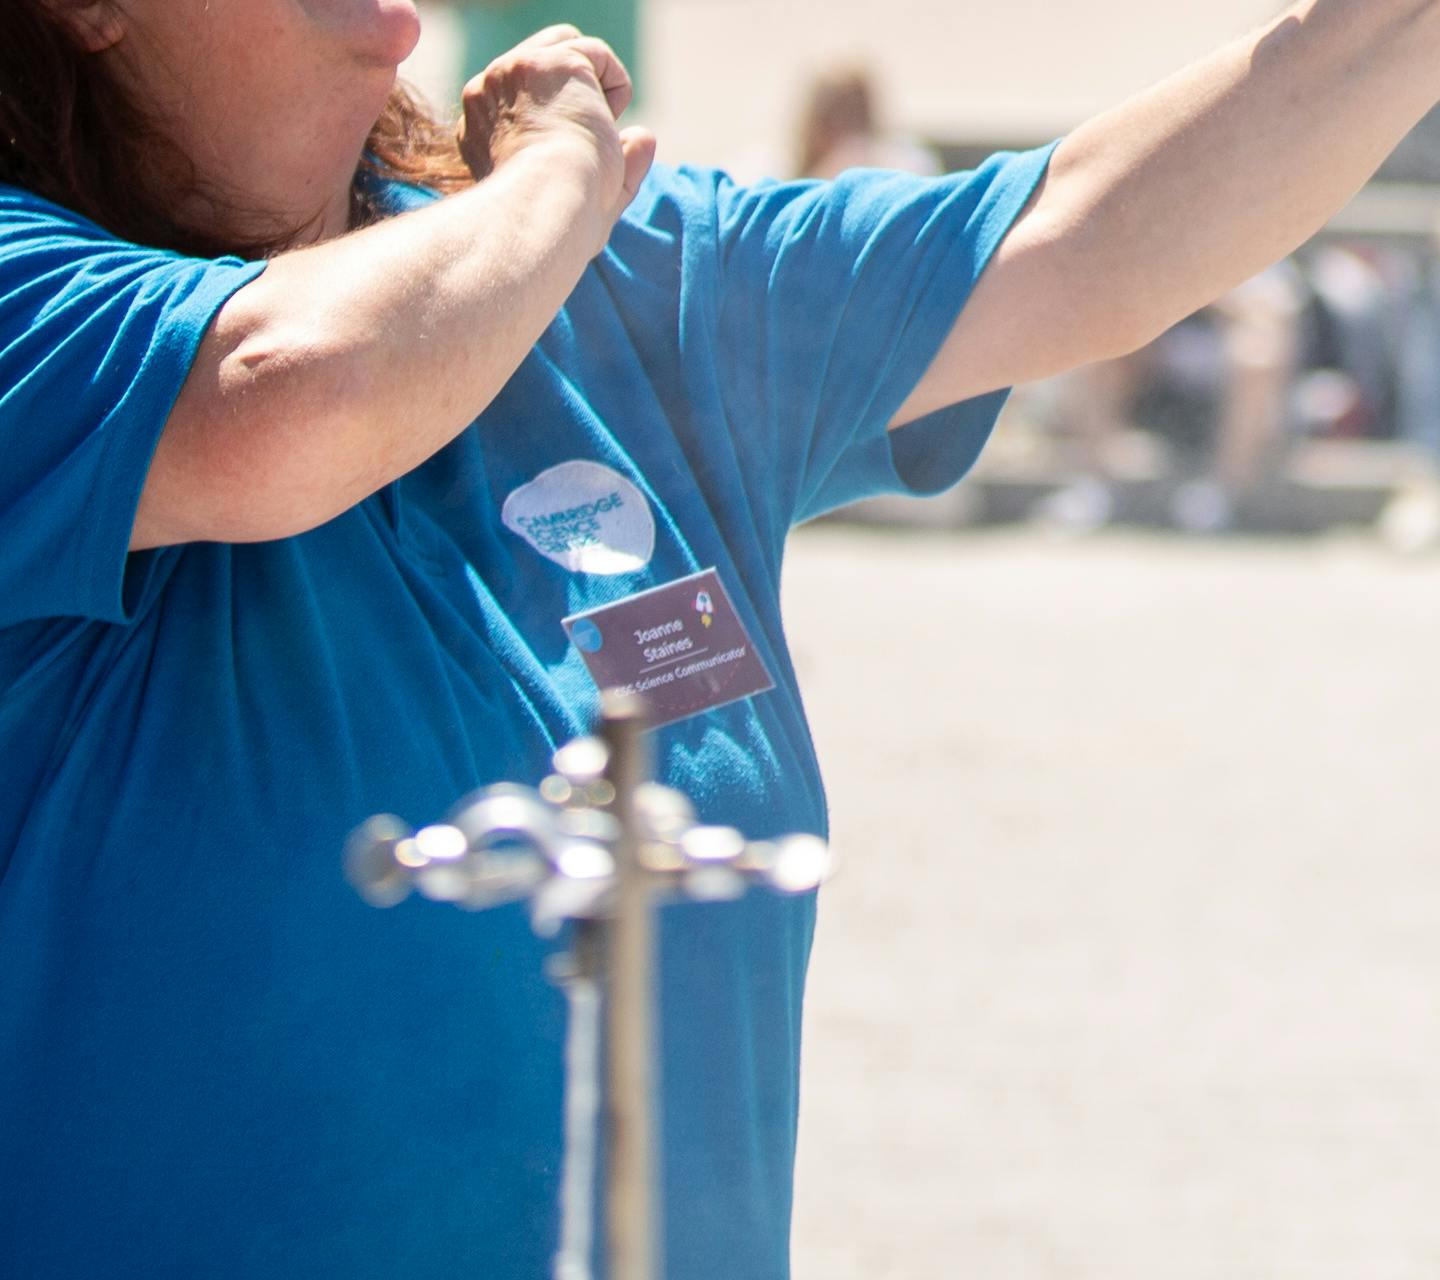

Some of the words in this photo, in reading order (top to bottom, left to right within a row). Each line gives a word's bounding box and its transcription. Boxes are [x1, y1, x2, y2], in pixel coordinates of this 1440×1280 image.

[516, 490, 624, 528] CAMBRIDGE
[526, 517, 601, 543] SCIENCE
[537, 533, 598, 553] CENE
[633, 618, 684, 645] Joanne
[642, 636, 694, 663] Staines
[635, 671, 675, 692] Science
[674, 645, 747, 679] Communicator
